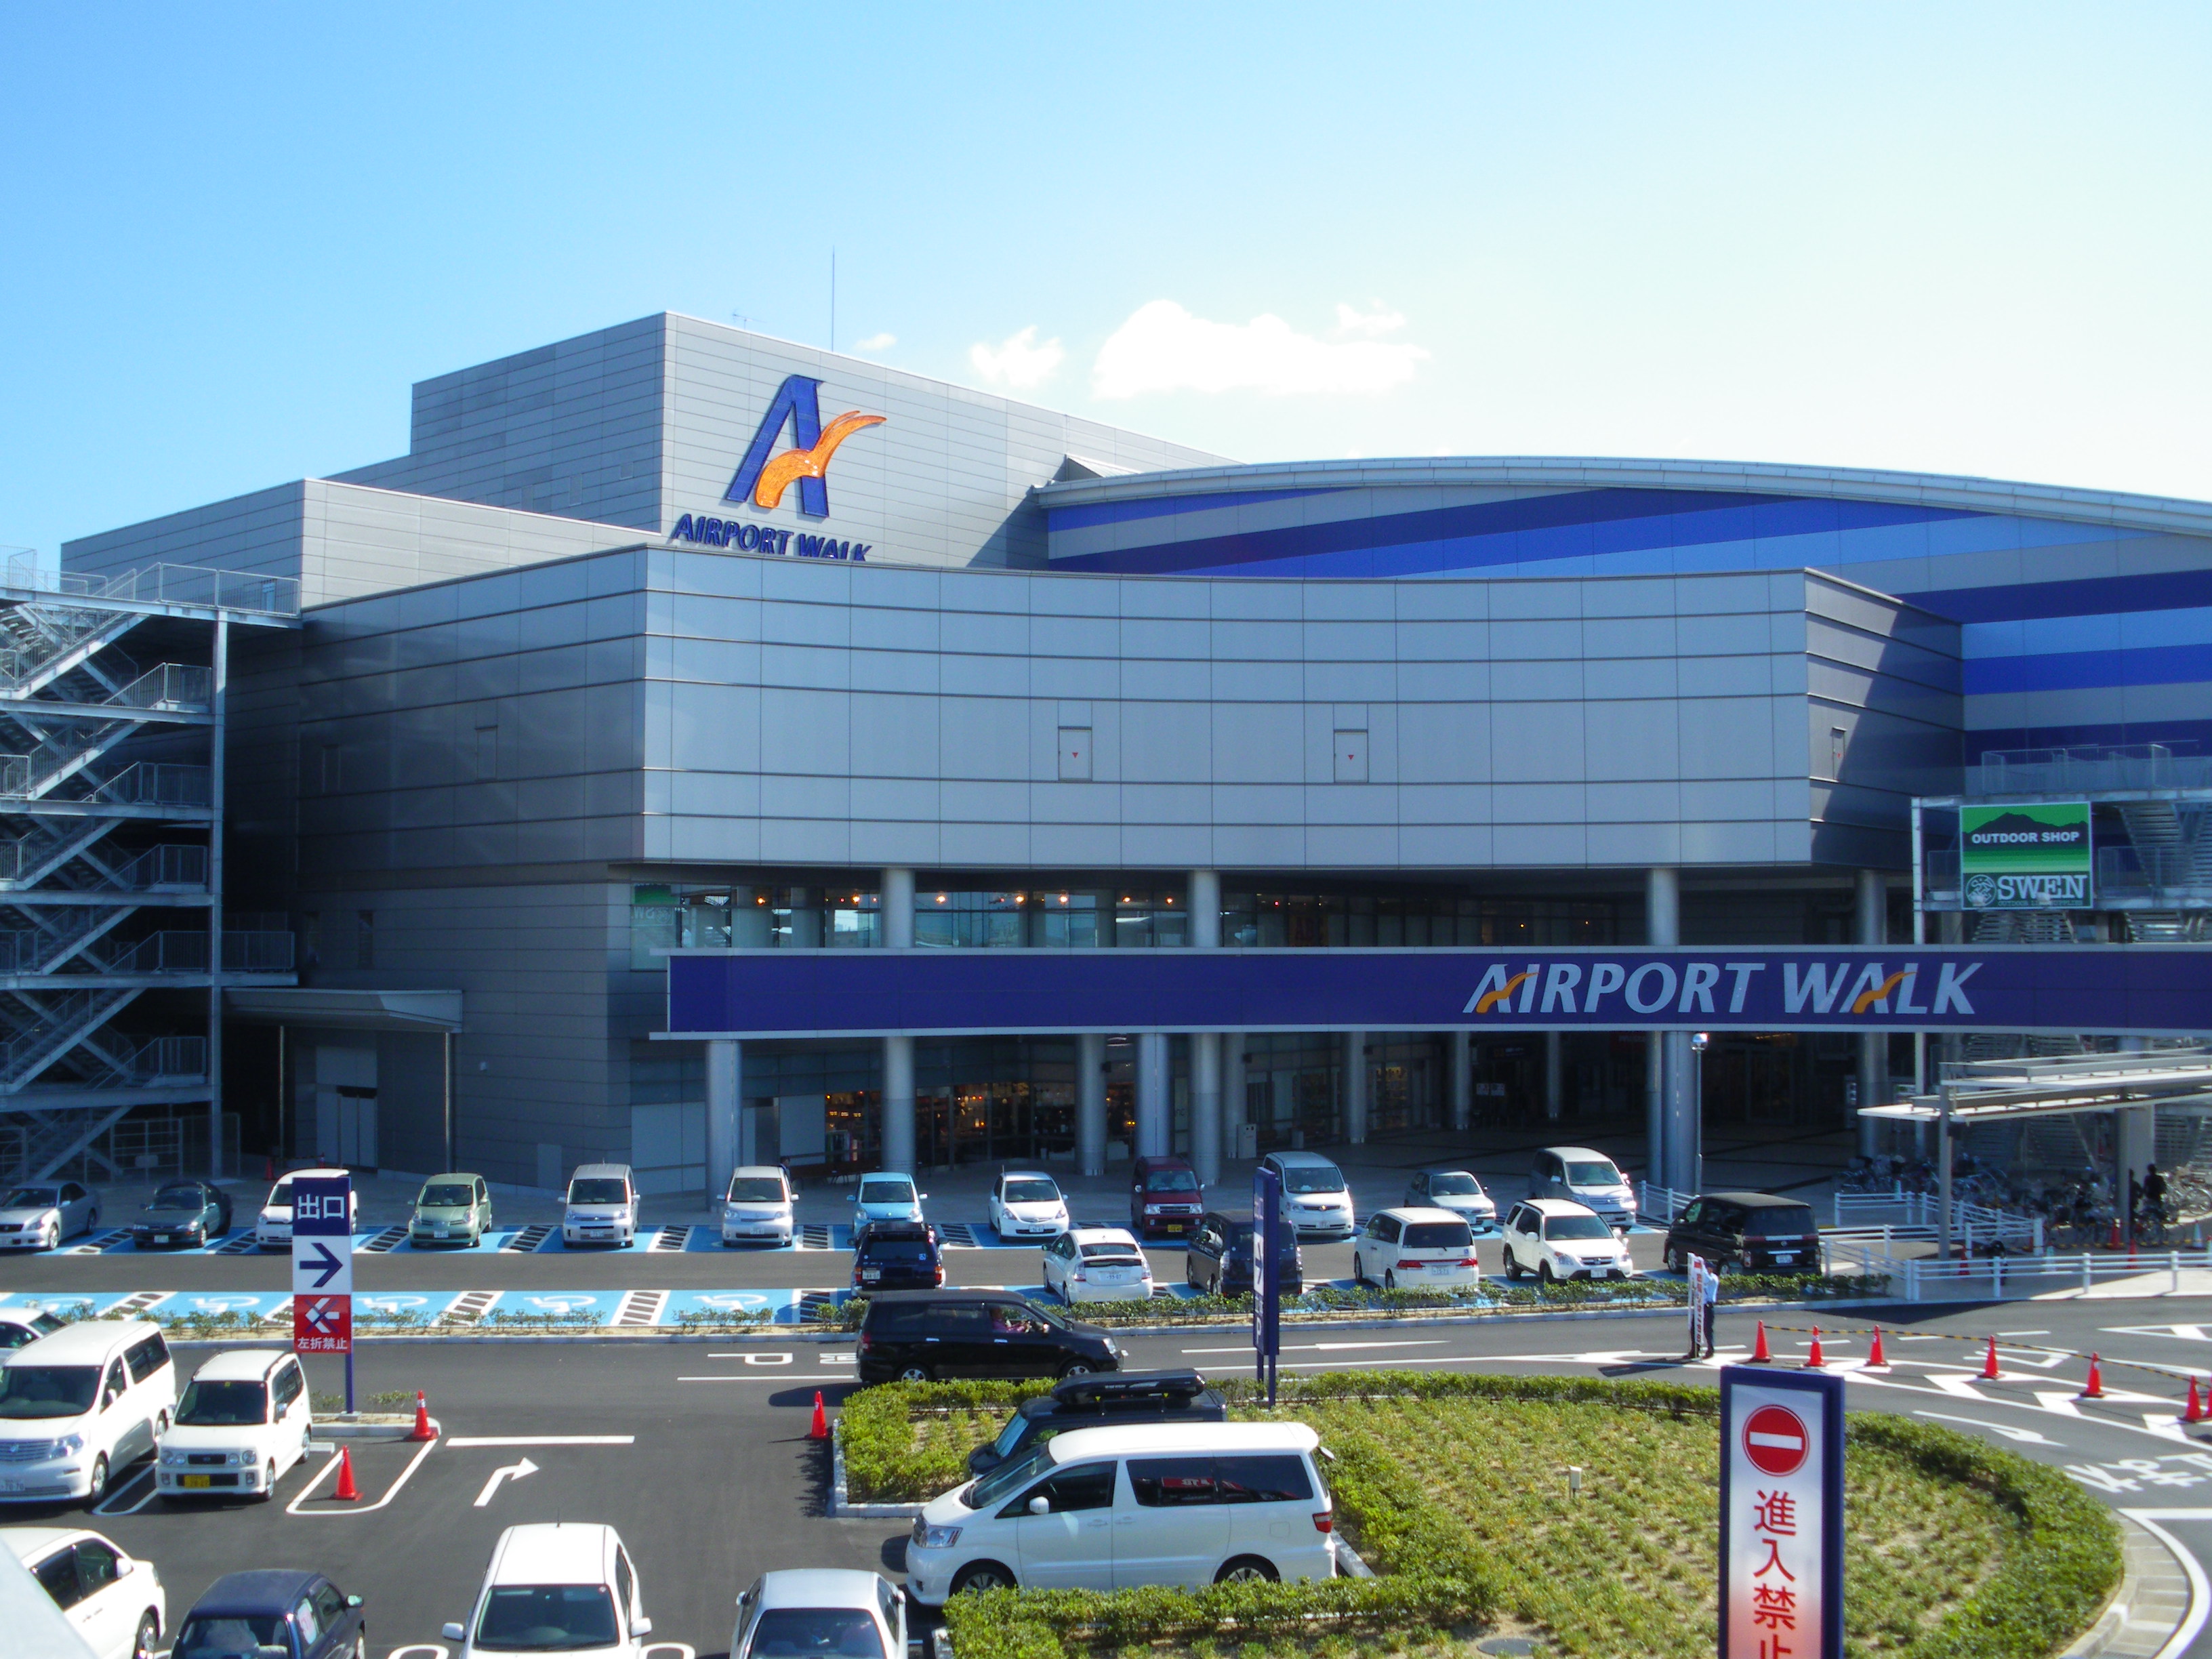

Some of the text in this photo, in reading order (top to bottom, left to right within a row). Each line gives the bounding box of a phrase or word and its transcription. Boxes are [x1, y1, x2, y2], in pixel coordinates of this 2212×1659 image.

[672, 513, 794, 555] AIRPORT
[1971, 831, 2080, 844] OUTDOOR SHOP
[1996, 874, 2088, 901] SWEN
[1462, 962, 1983, 1015] AIRPORT WALK
[297, 1193, 345, 1220] 出口
[297, 1336, 348, 1351] 左折禁止
